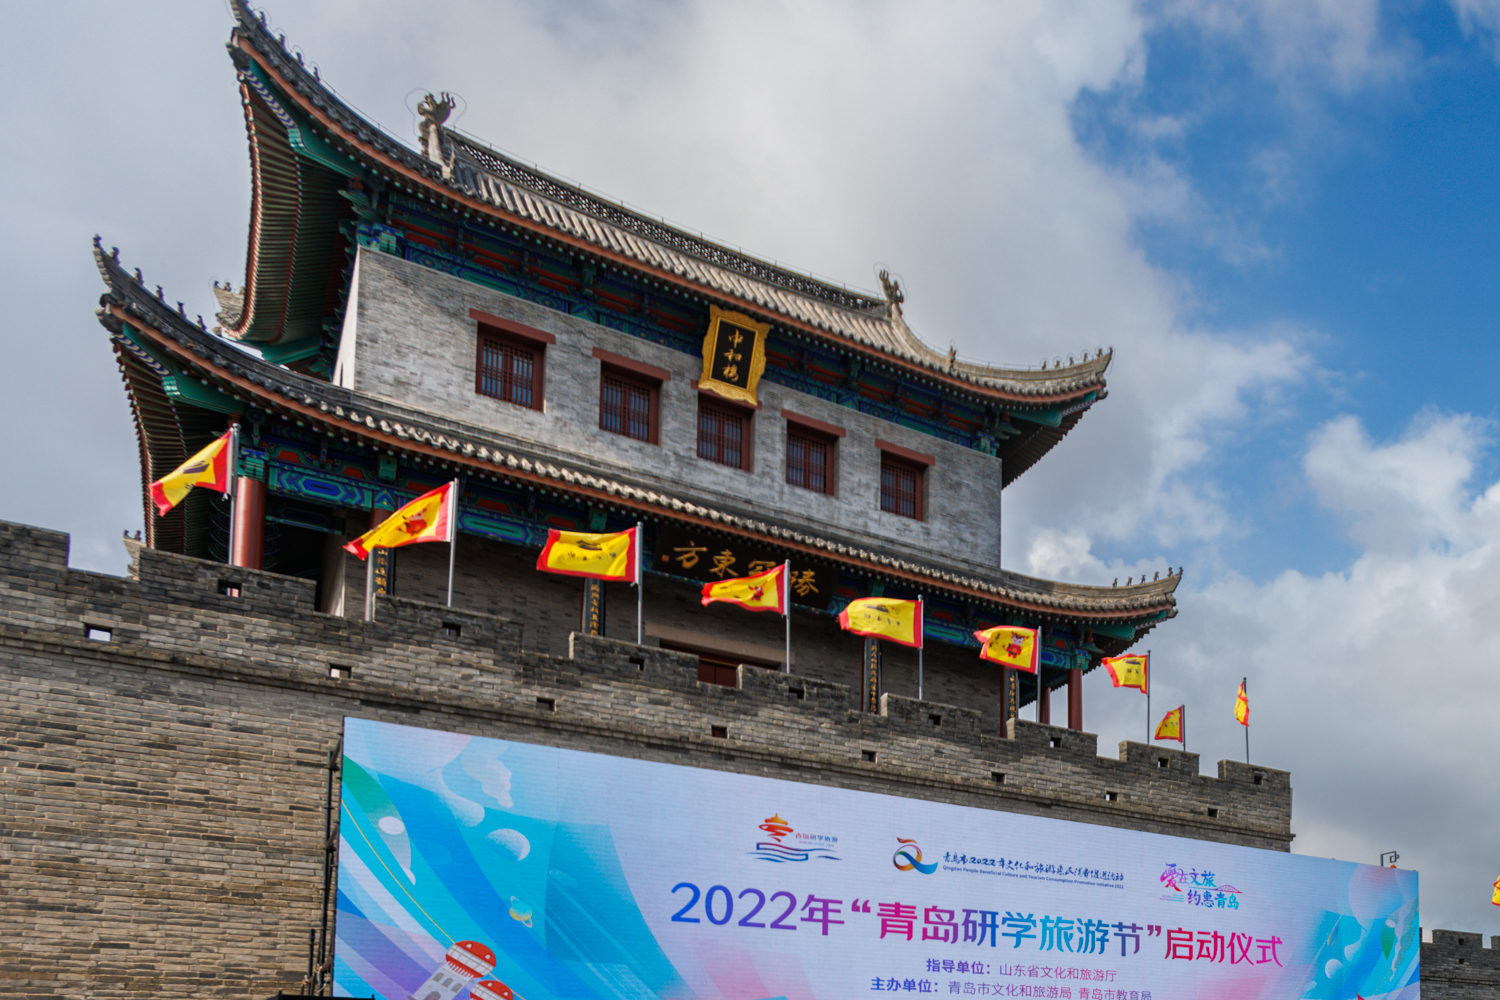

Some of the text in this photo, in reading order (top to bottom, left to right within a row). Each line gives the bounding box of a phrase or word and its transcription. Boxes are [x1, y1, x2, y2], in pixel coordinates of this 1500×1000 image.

[980, 868, 1001, 876] Beneficial
[1187, 889, 1239, 910] 约惠青岛
